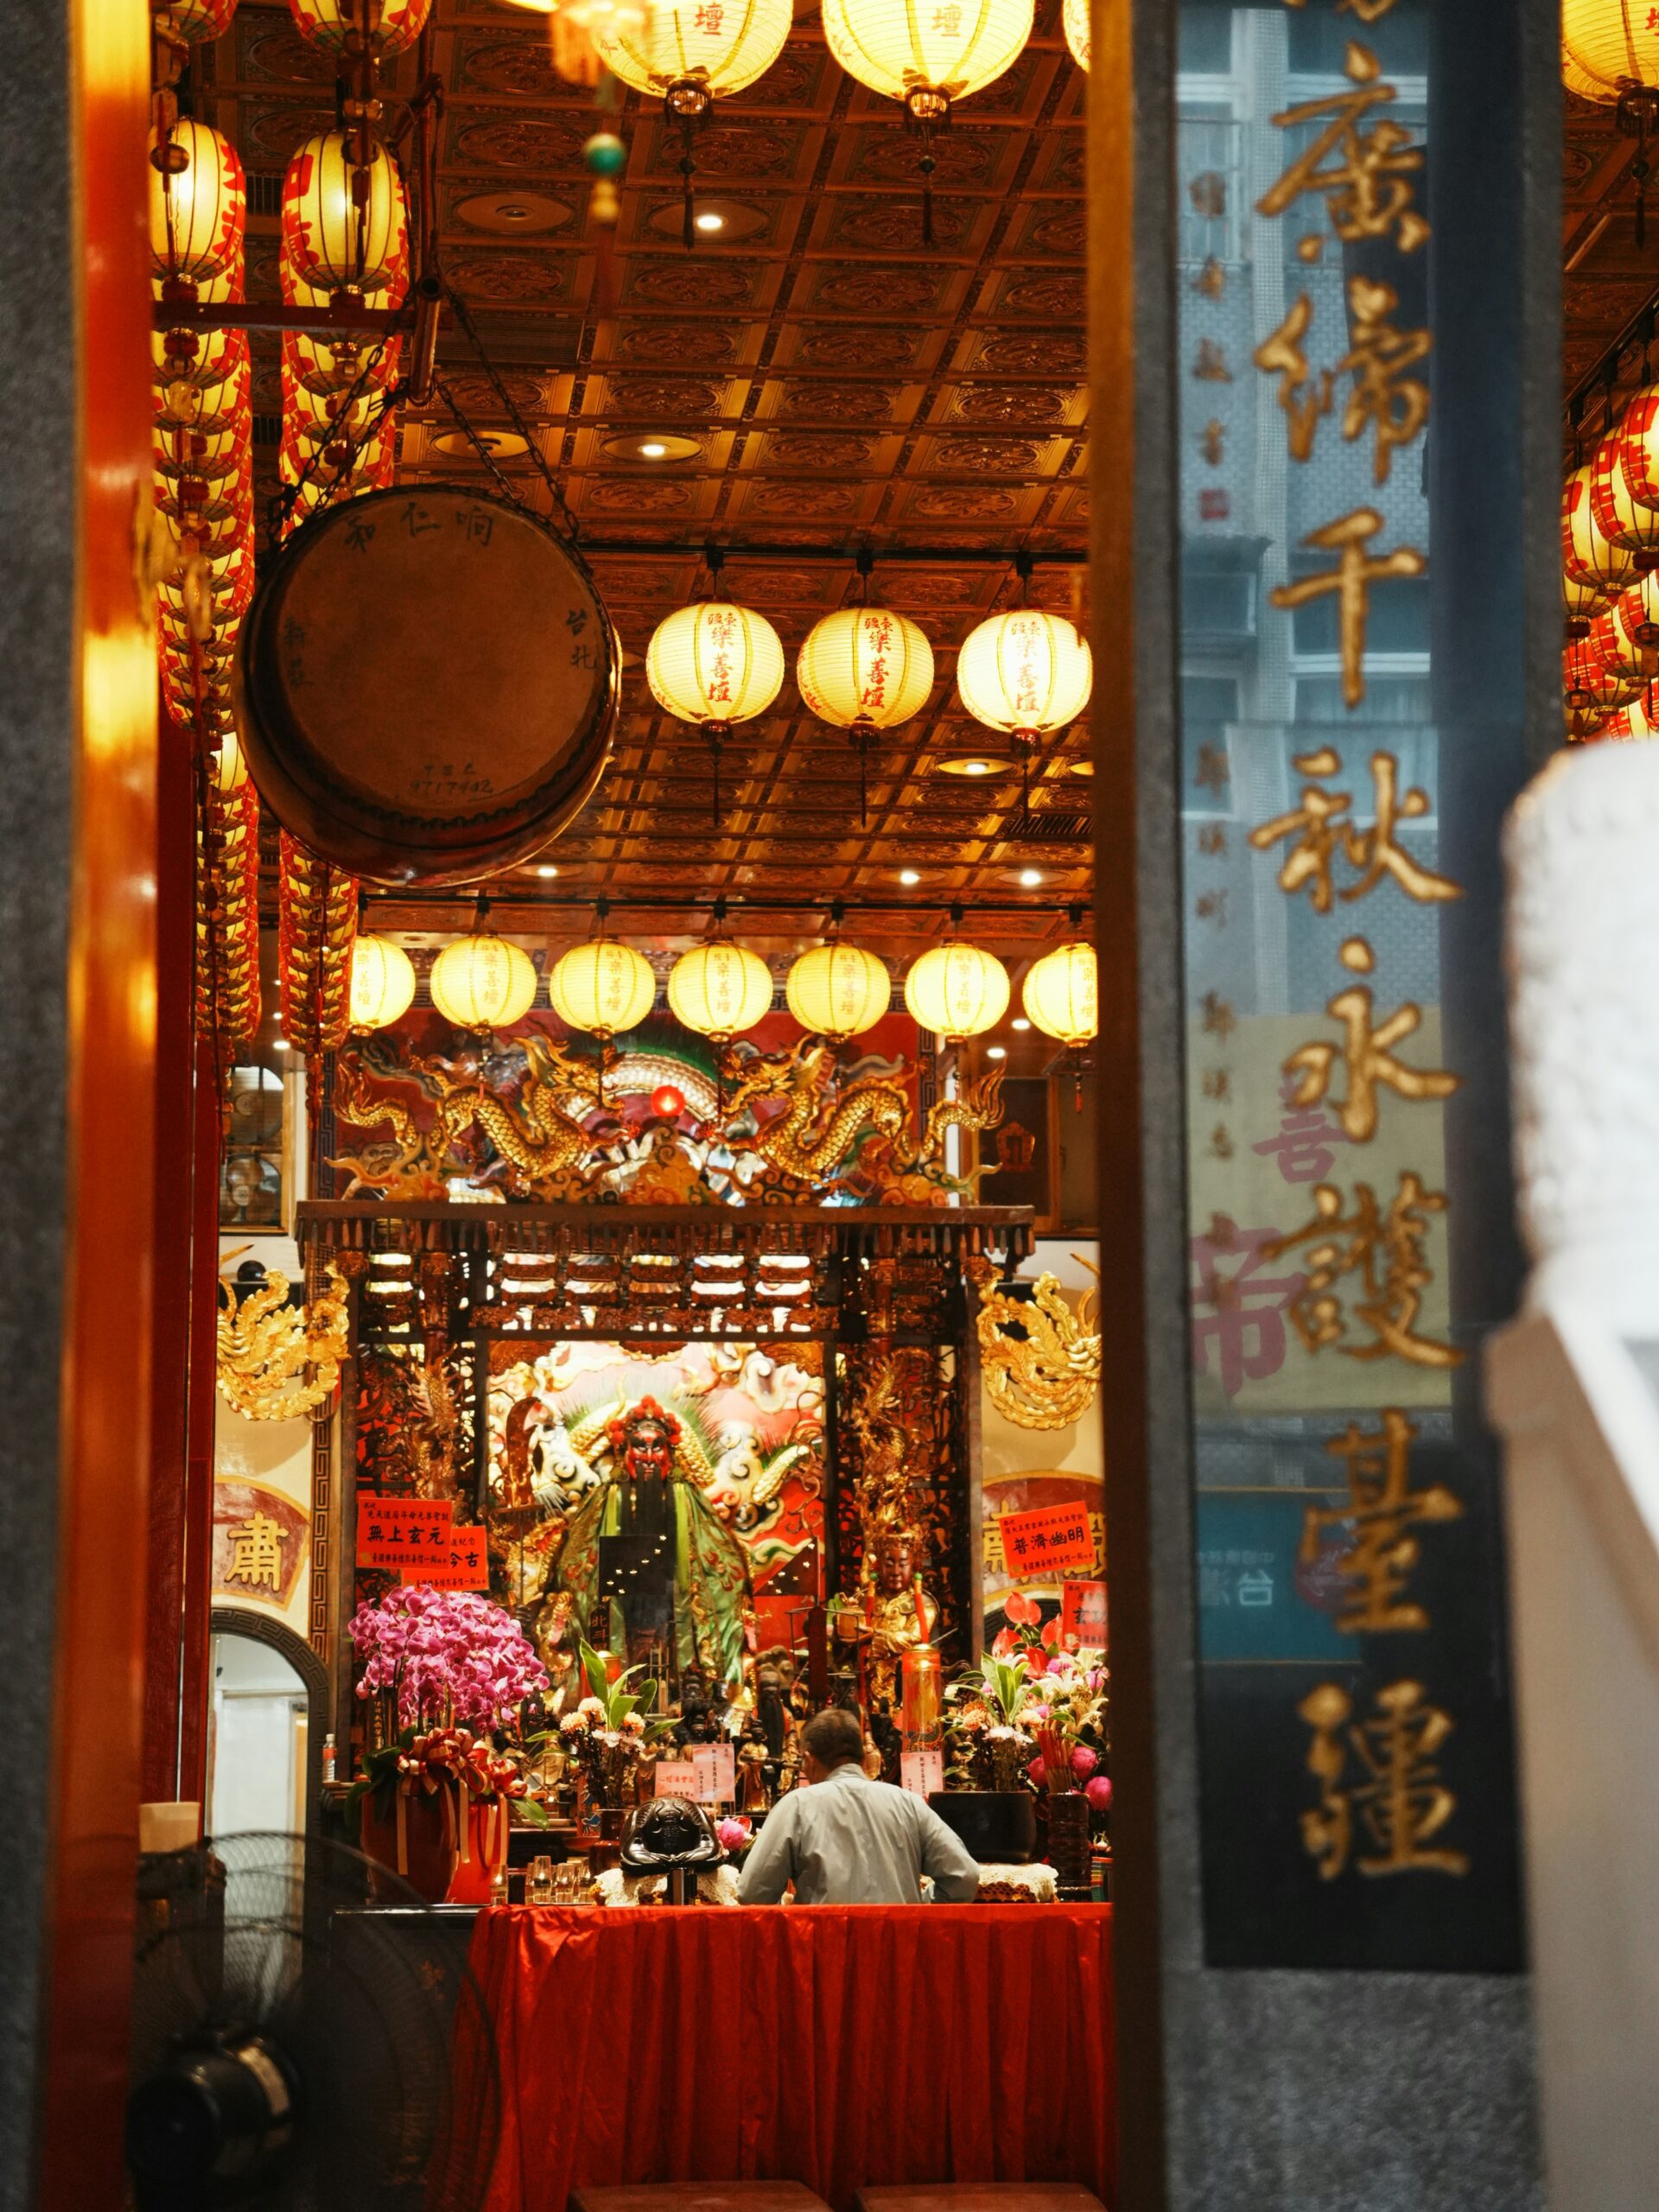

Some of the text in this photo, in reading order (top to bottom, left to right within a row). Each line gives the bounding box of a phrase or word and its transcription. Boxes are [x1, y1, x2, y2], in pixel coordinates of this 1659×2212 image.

[366, 1524, 445, 1545] 無上玄元
[1013, 1526, 1085, 1555] 普濟幽明
